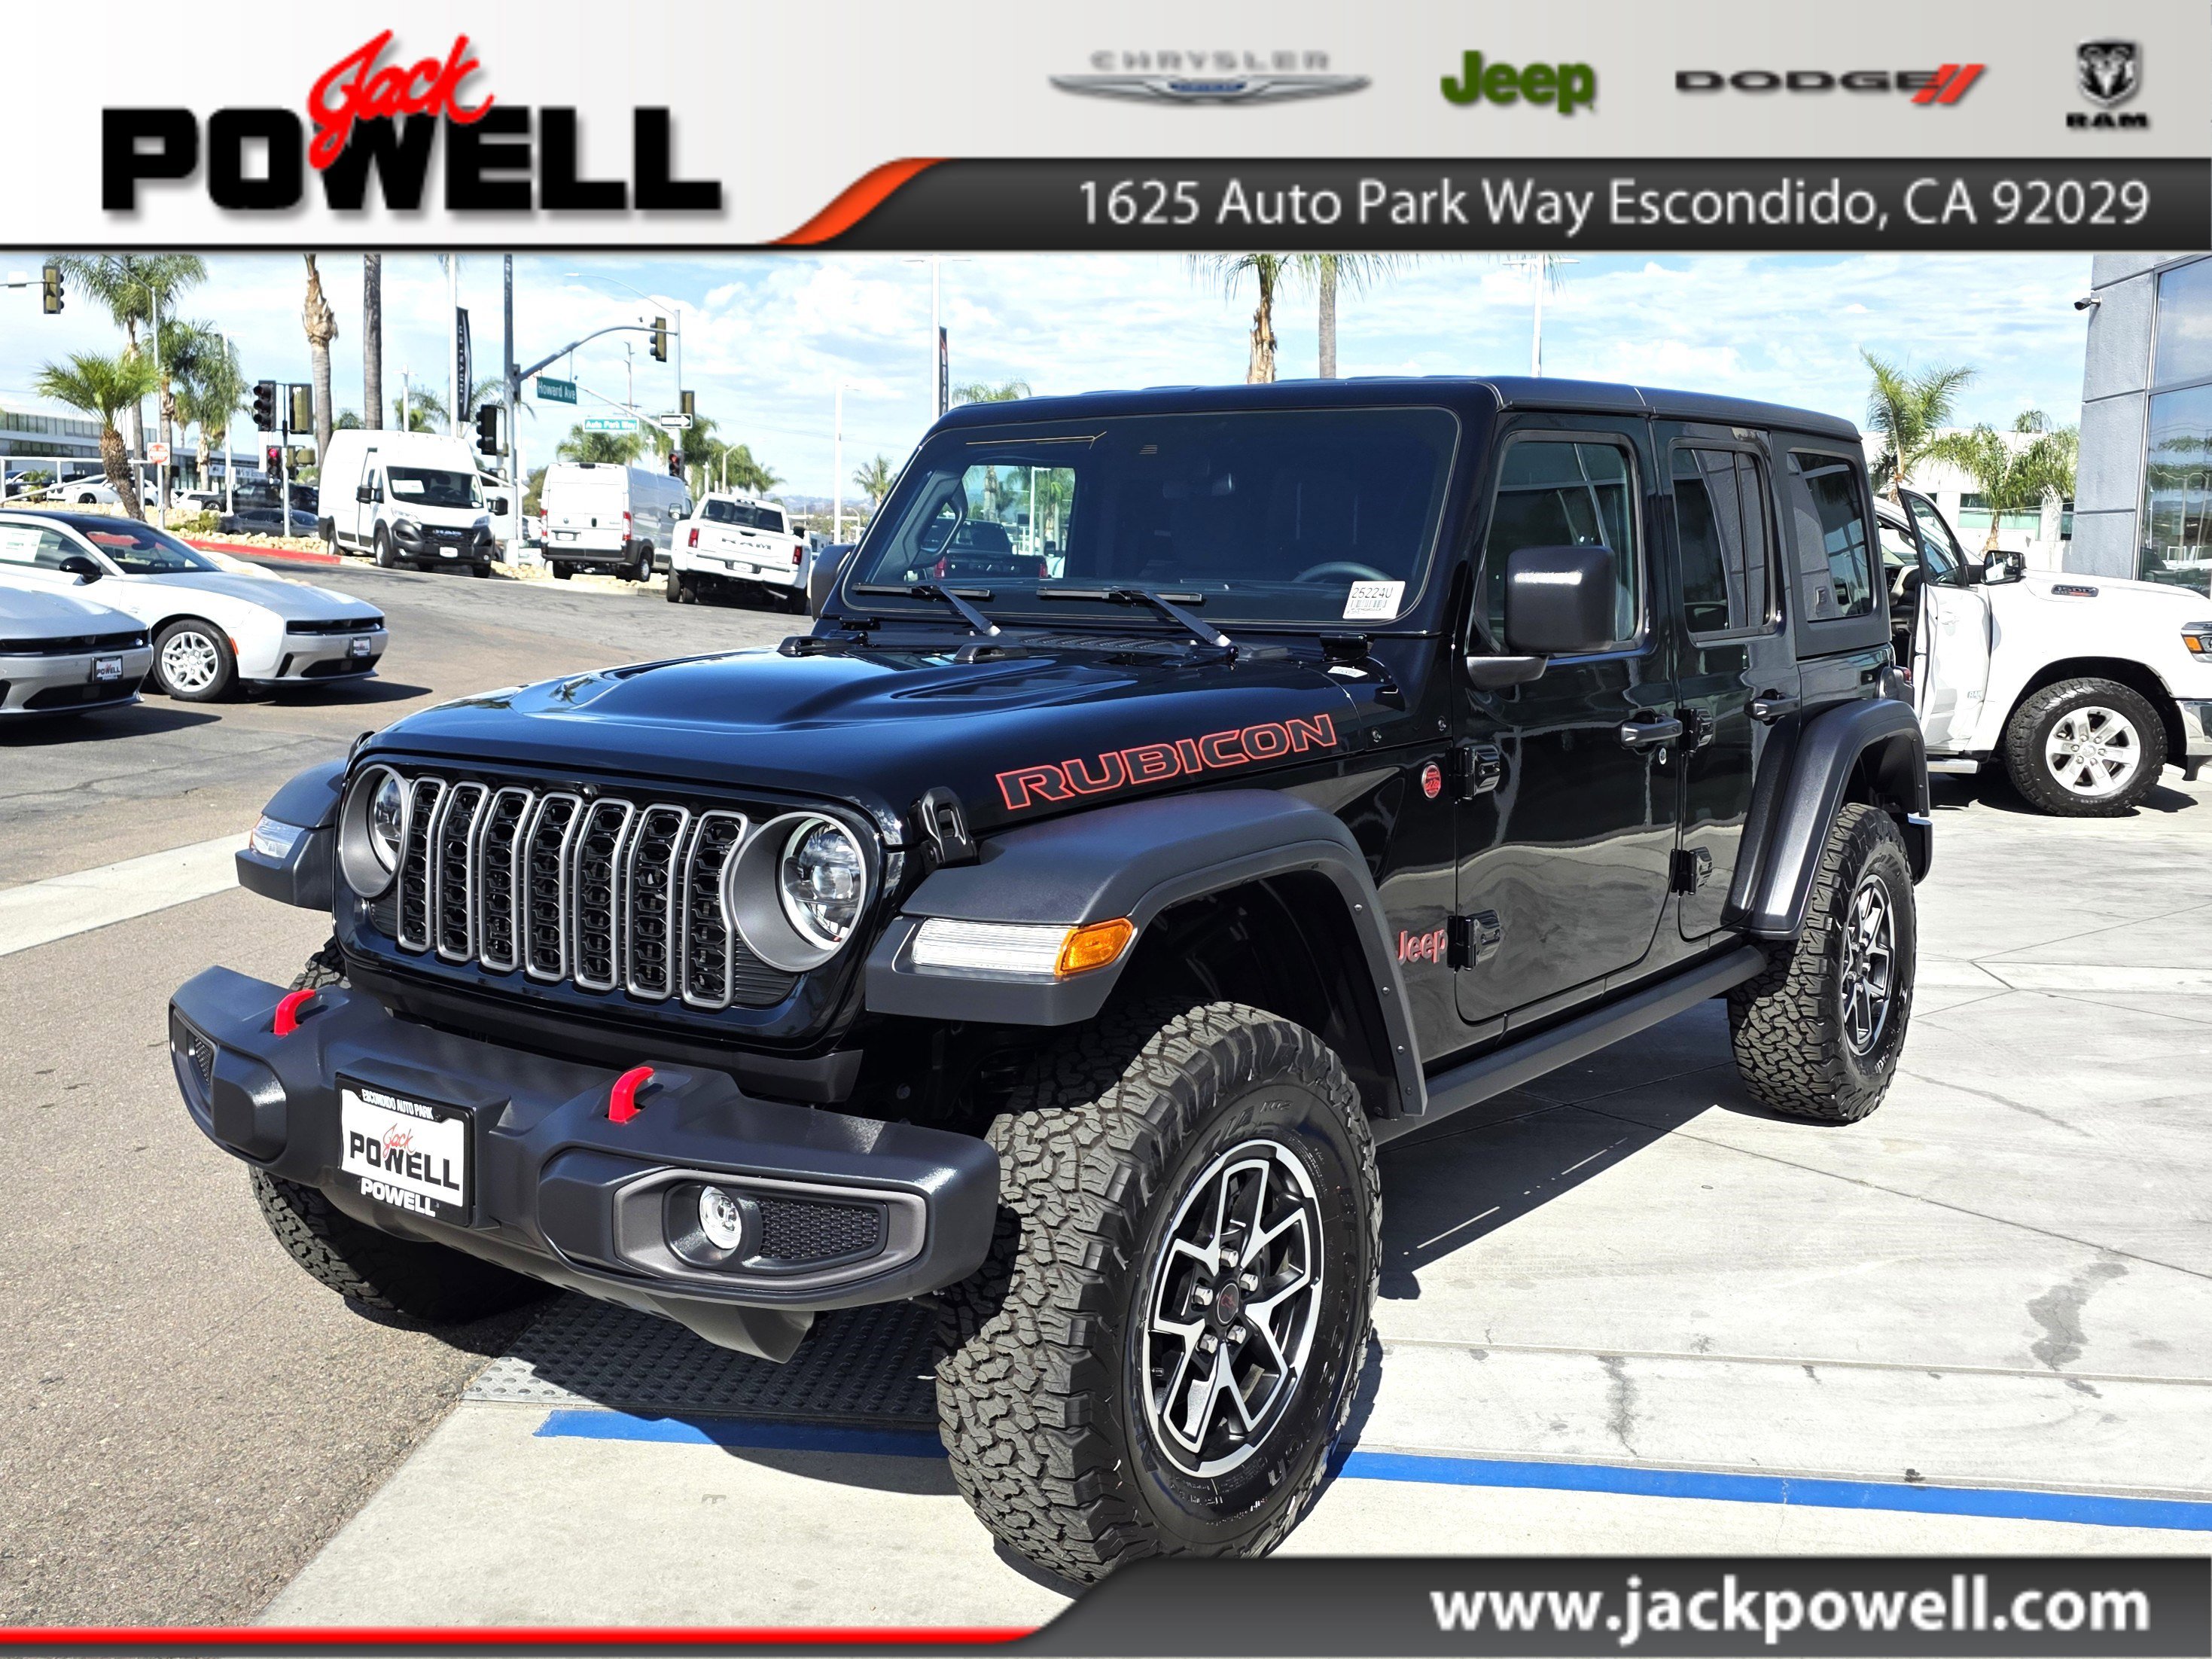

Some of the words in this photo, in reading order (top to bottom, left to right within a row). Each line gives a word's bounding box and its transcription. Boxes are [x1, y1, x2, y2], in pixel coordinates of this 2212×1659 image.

[538, 381, 562, 398] Howard
[565, 386, 577, 400] Ave
[586, 420, 602, 428] Auto
[604, 420, 620, 429] Park
[622, 420, 636, 430] Way
[995, 714, 1337, 810] RUBICON
[1398, 929, 1448, 965] Jeep
[397, 1099, 414, 1115] AUTO
[413, 1104, 434, 1121] PARK
[382, 1123, 416, 1158] Jack
[349, 1130, 460, 1191] POWELL
[361, 1177, 436, 1218] POWELL
